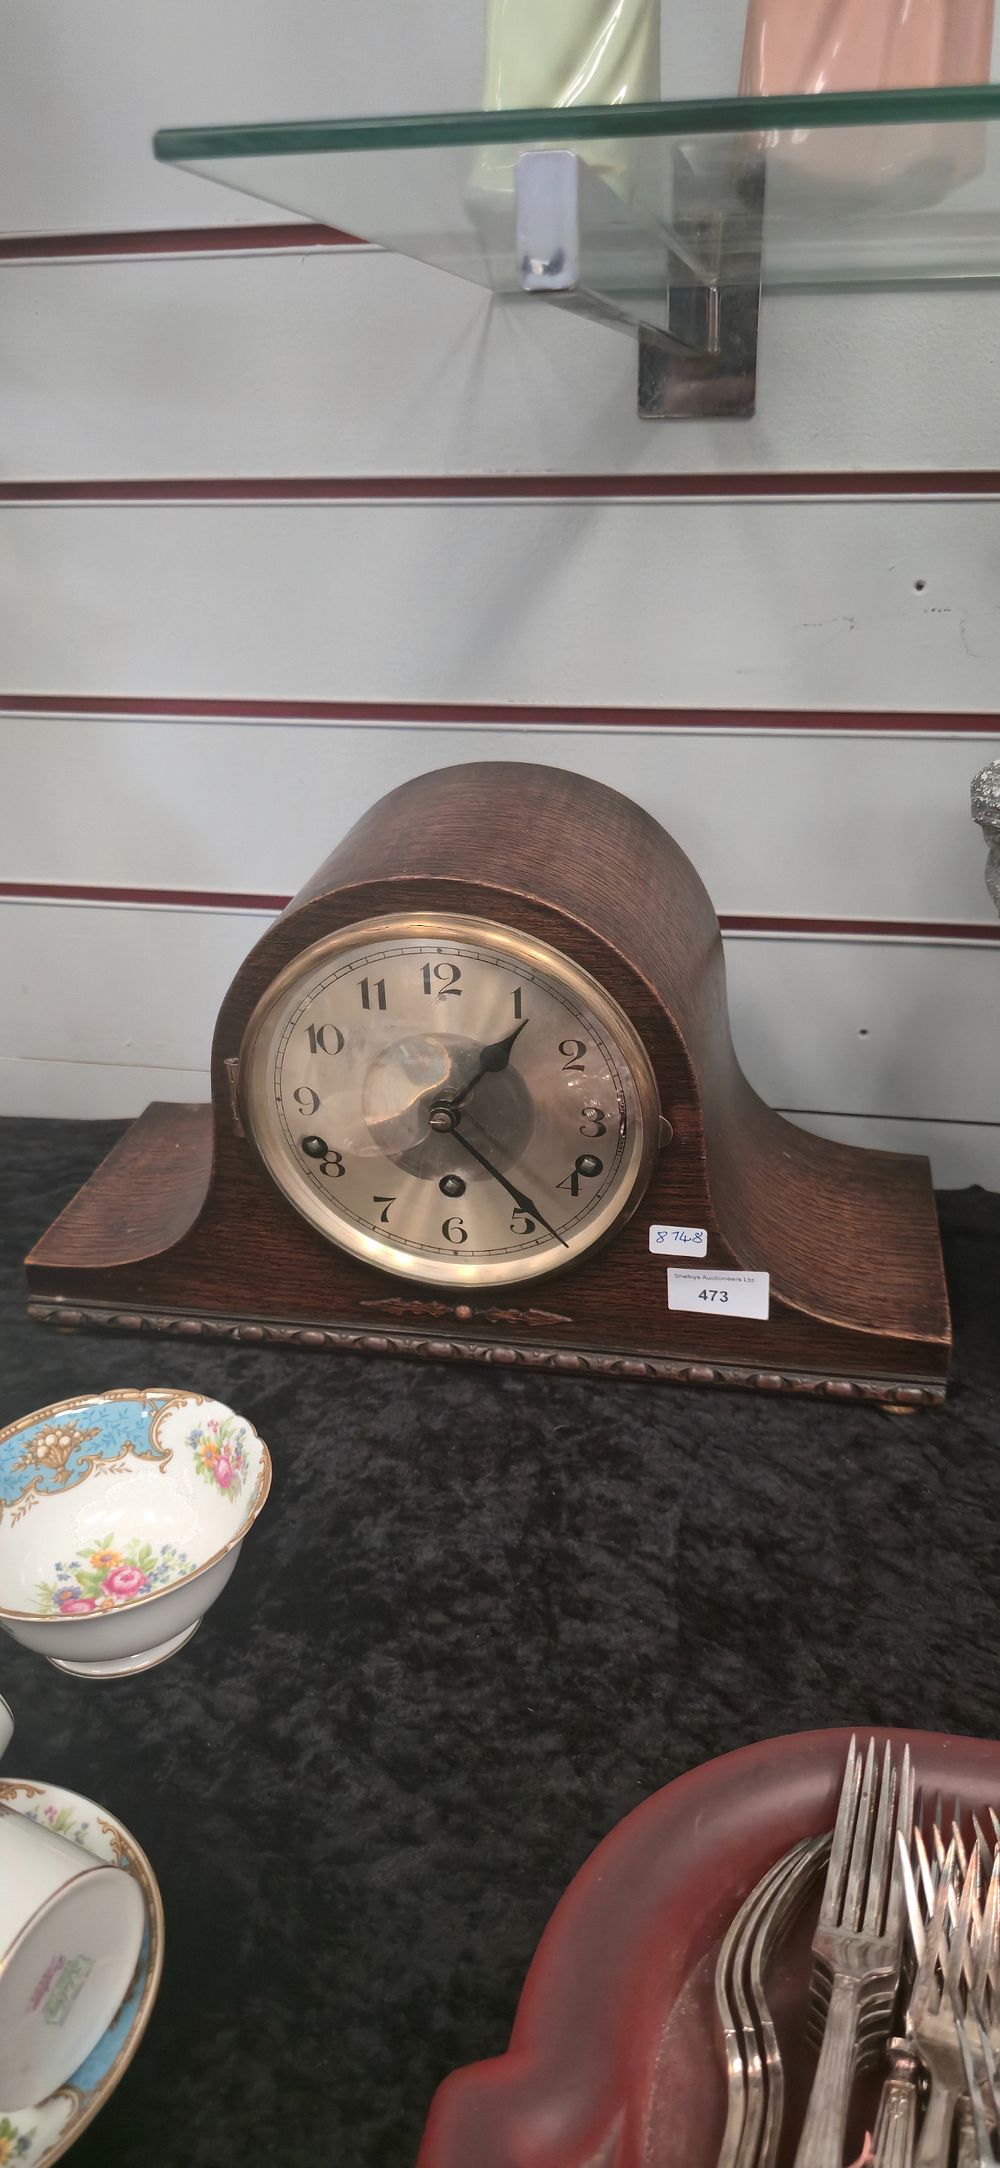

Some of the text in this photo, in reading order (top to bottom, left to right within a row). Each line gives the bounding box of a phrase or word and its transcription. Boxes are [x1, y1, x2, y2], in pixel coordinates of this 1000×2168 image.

[356, 976, 387, 1010] 11
[420, 962, 462, 996] 12
[510, 987, 522, 1019] 1
[305, 1023, 345, 1055] 10
[558, 1039, 586, 1071] 2
[293, 1087, 320, 1116] 9
[579, 1107, 606, 1137] 3
[319, 1150, 346, 1177] 8
[556, 1168, 583, 1196] 4
[373, 1196, 396, 1223] 7
[510, 1208, 535, 1234] 5
[442, 1217, 468, 1244] 6
[698, 1289, 729, 1302] 473
